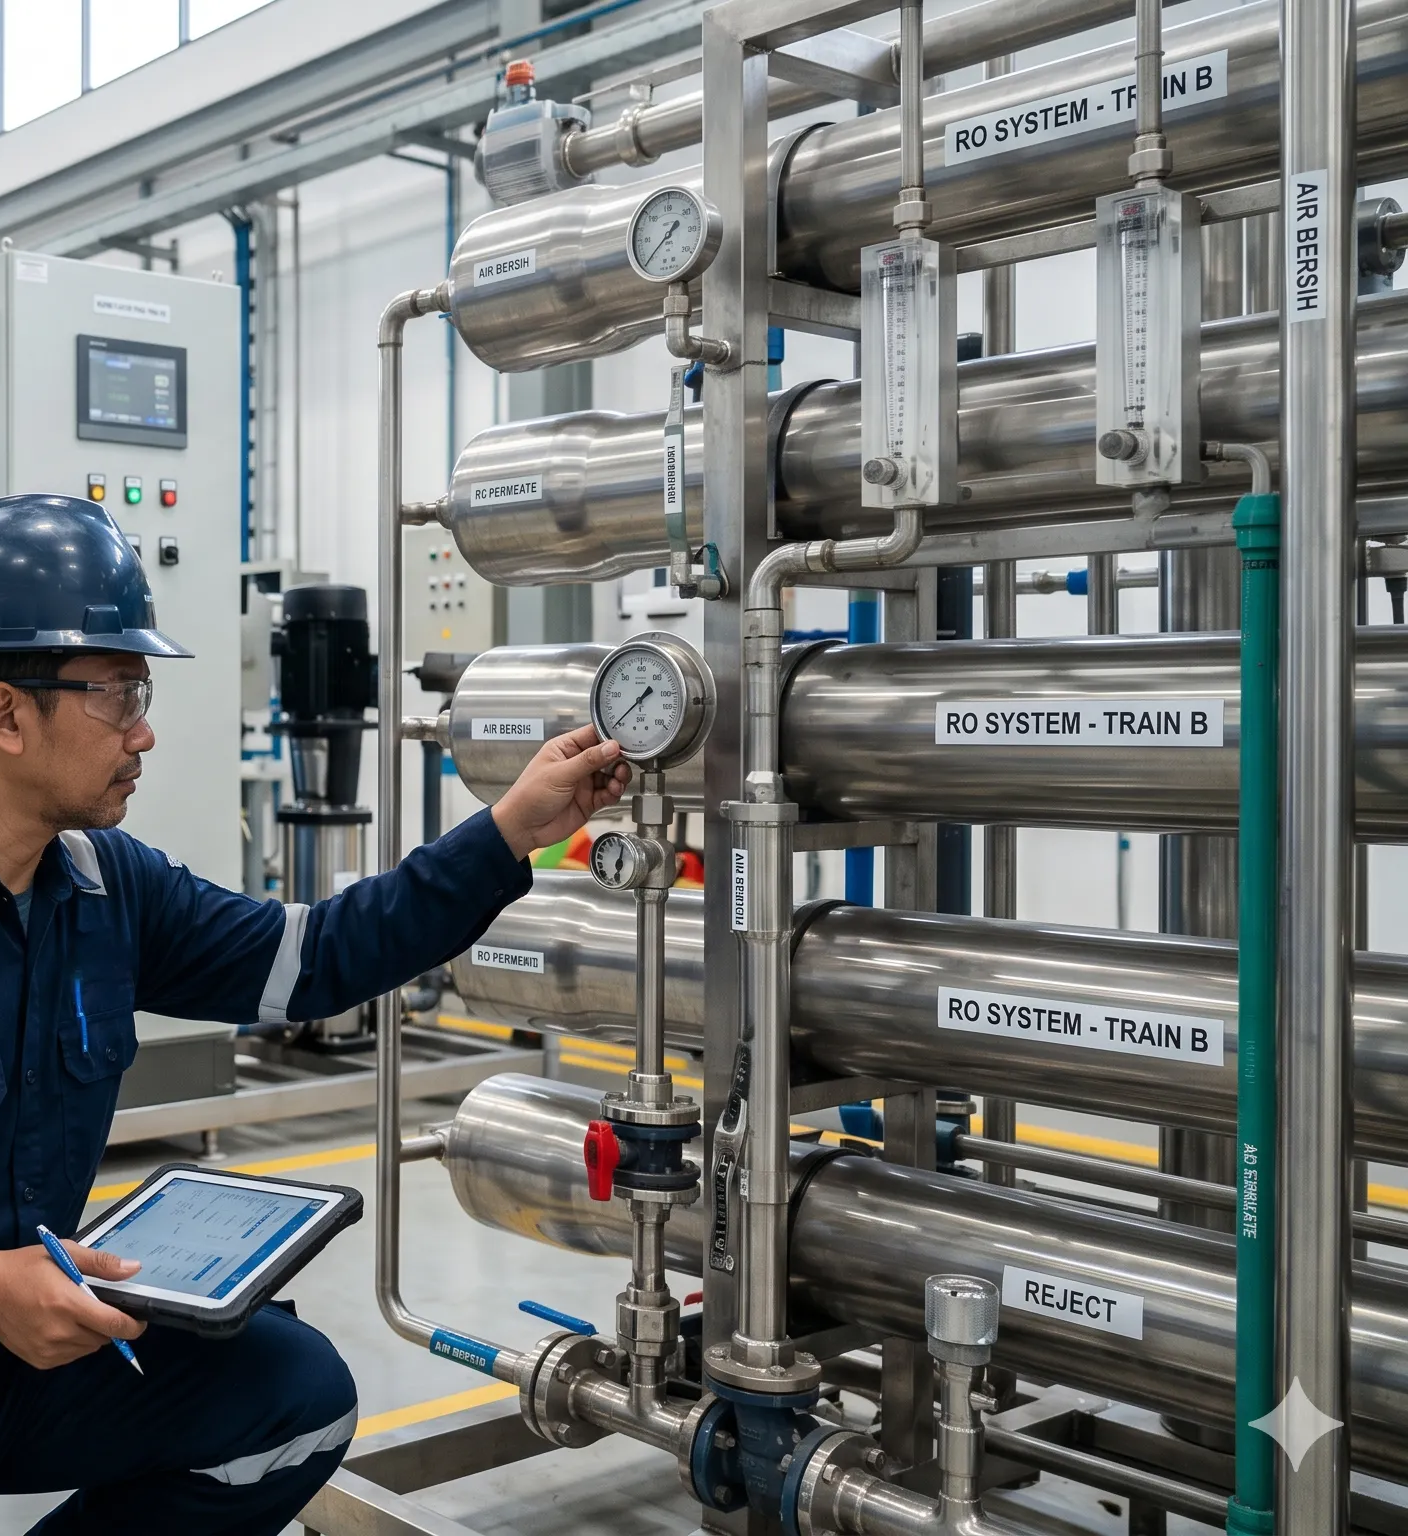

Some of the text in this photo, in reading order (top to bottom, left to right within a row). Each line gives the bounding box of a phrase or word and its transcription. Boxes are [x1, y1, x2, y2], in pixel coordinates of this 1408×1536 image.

[956, 124, 988, 153] RO
[994, 97, 1088, 142] SYSTEM
[1111, 71, 1186, 112] TRIN
[1196, 65, 1213, 92] B
[1296, 183, 1319, 311] AIR BERSIH
[478, 256, 530, 278] AIR BERSIH
[488, 482, 537, 498] PERMEATE
[482, 724, 498, 734] AIR
[946, 712, 978, 734] RO
[985, 712, 1082, 735] SYSTEM
[1103, 711, 1182, 735] TRAIN
[1191, 712, 1208, 735] B
[478, 950, 490, 962] RO
[948, 997, 980, 1022] RO
[987, 1002, 1082, 1036] SYSTEM
[1104, 1016, 1182, 1050] TRAIN
[1191, 1027, 1208, 1053] B
[1025, 1280, 1117, 1322] REJECT
